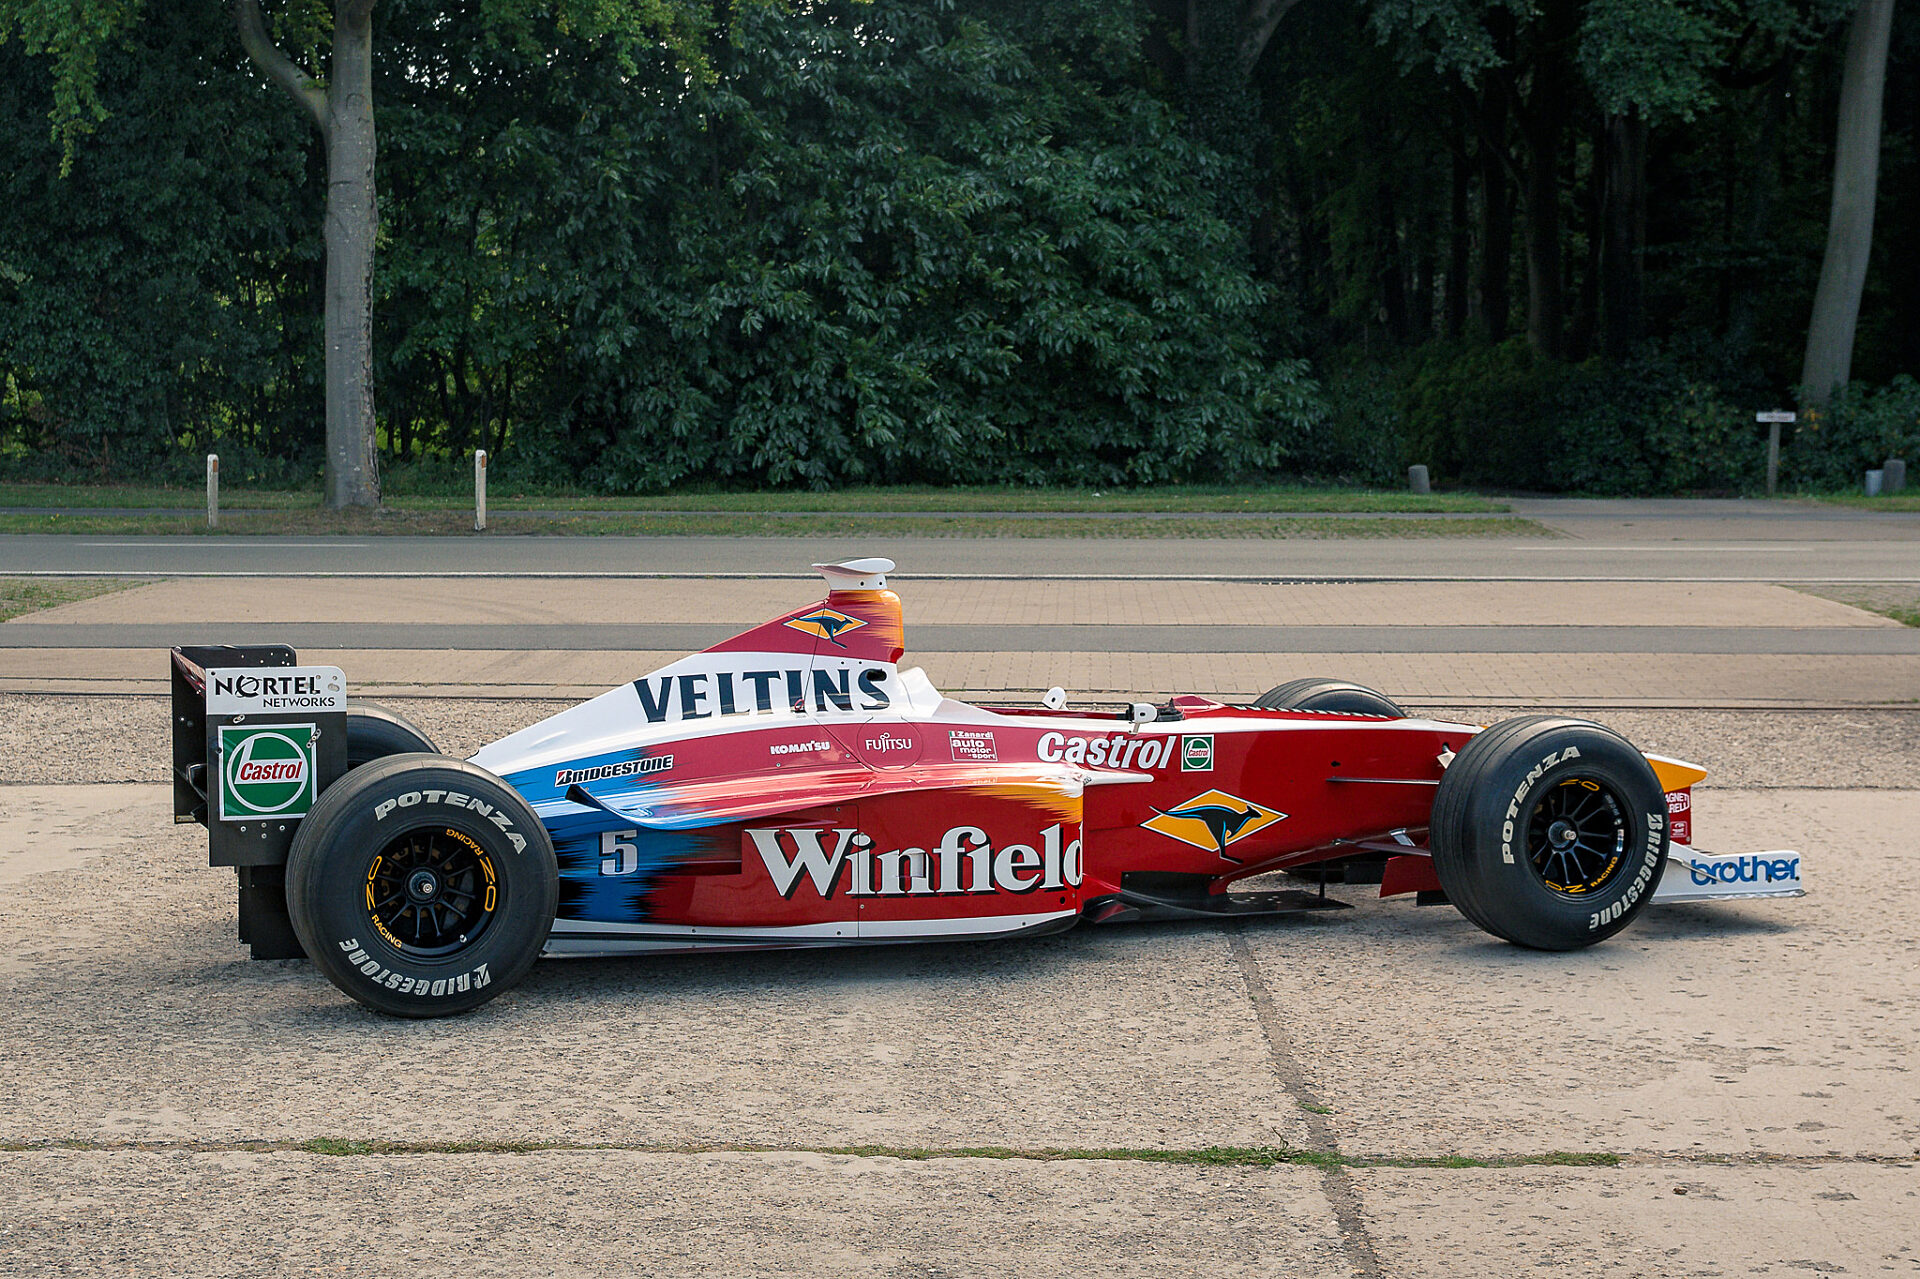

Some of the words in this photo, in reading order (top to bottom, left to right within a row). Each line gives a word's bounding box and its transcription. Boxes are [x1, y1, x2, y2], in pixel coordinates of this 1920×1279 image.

[215, 675, 321, 698] NORTEL
[263, 697, 335, 708] NETWORKS
[633, 668, 891, 723] VELTINS
[770, 740, 831, 754] KOMATSU
[865, 732, 912, 753] FUJITSU
[952, 739, 985, 748] auto
[1037, 731, 1178, 769] Castrol
[1187, 749, 1209, 758] Castrol
[240, 761, 303, 781] Castrol
[555, 754, 674, 787] BRIDGESTONE
[1502, 746, 1581, 864] POTENZA
[374, 790, 527, 854] POTENZA
[445, 828, 484, 856] RACING
[602, 829, 638, 876] 5
[744, 820, 1083, 897] Winfield
[1589, 813, 1663, 929] BRIDGESTONE
[1590, 856, 1619, 887] RACING
[1690, 856, 1799, 886] brother
[371, 914, 403, 948] RACING
[338, 938, 492, 996] BRIDGESTONE
